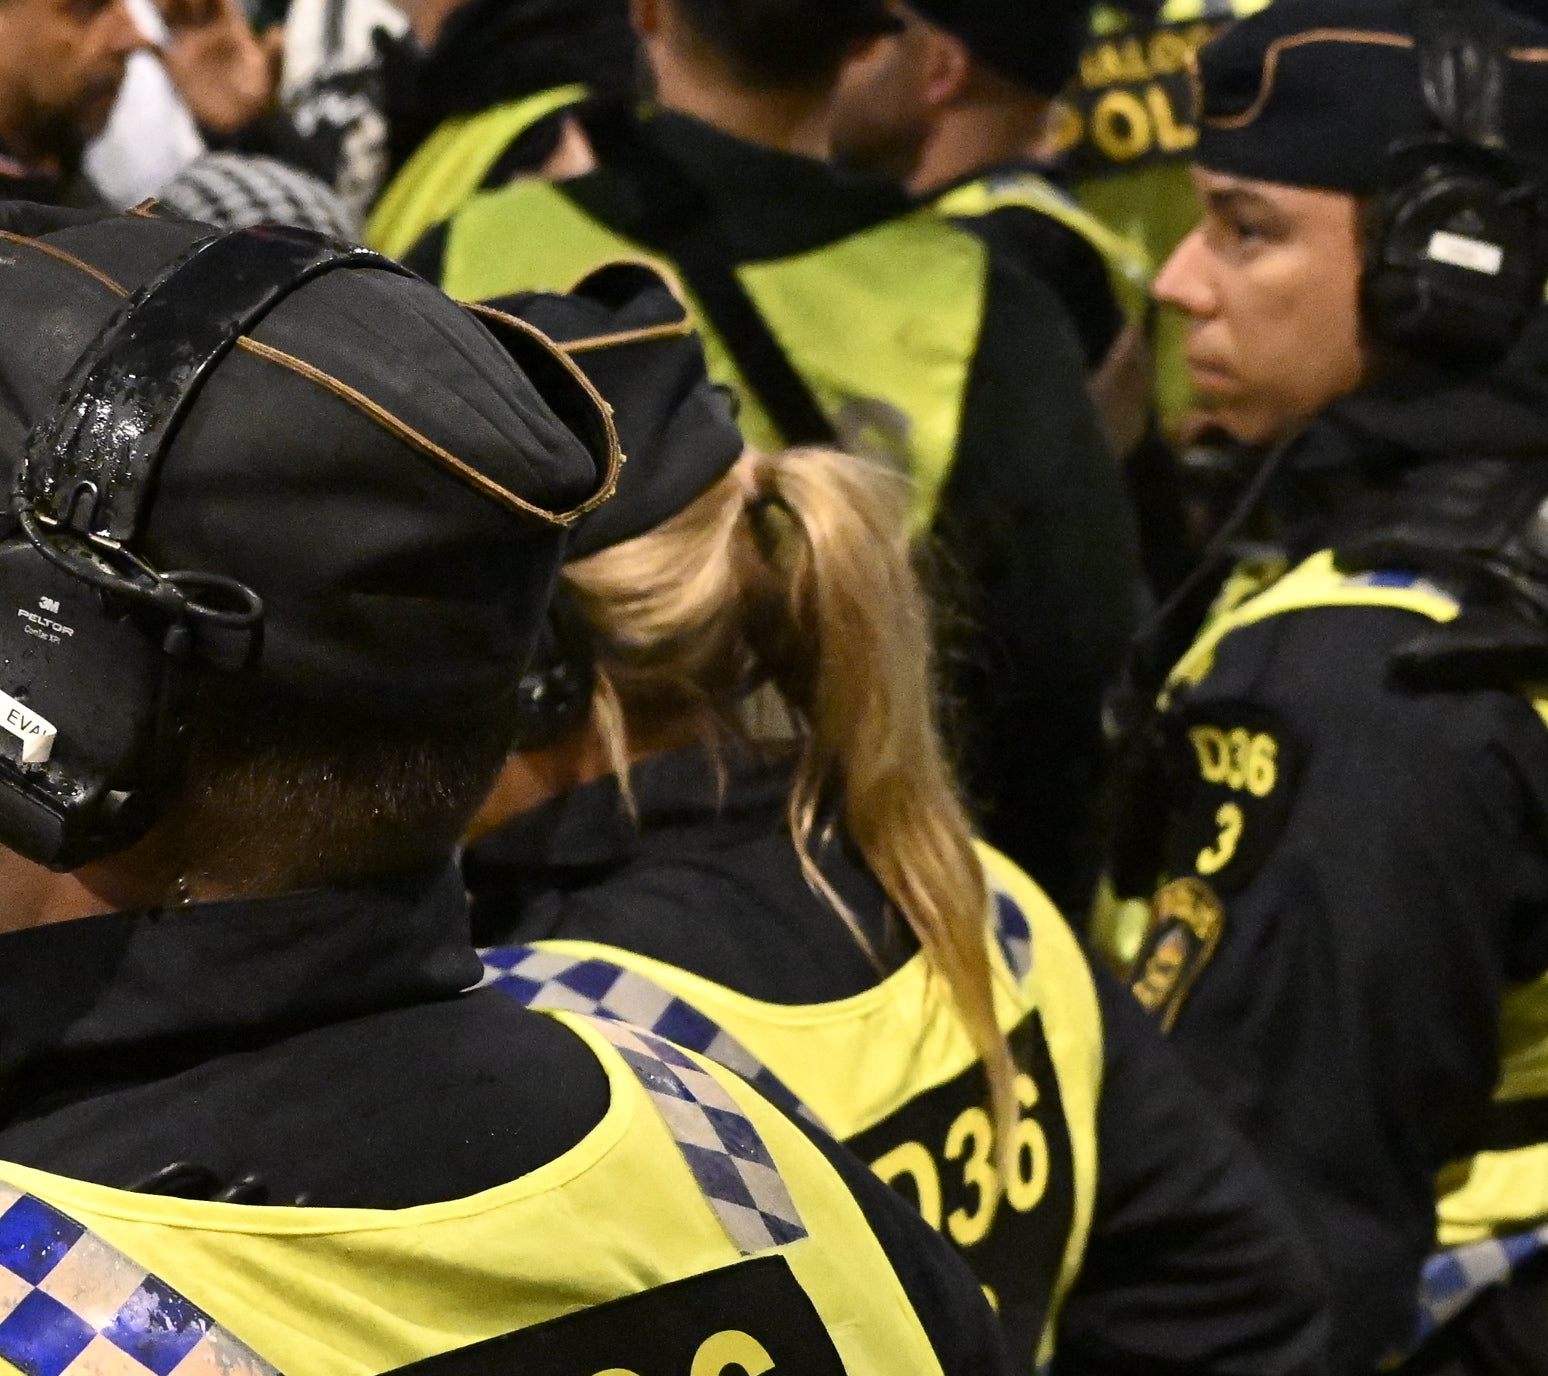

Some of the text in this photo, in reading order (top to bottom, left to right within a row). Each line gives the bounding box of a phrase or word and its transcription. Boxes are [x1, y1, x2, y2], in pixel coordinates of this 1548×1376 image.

[39, 596, 60, 613] 3M
[17, 609, 75, 636] PELTOR
[6, 709, 46, 735] EVA
[1195, 802, 1243, 874] 3
